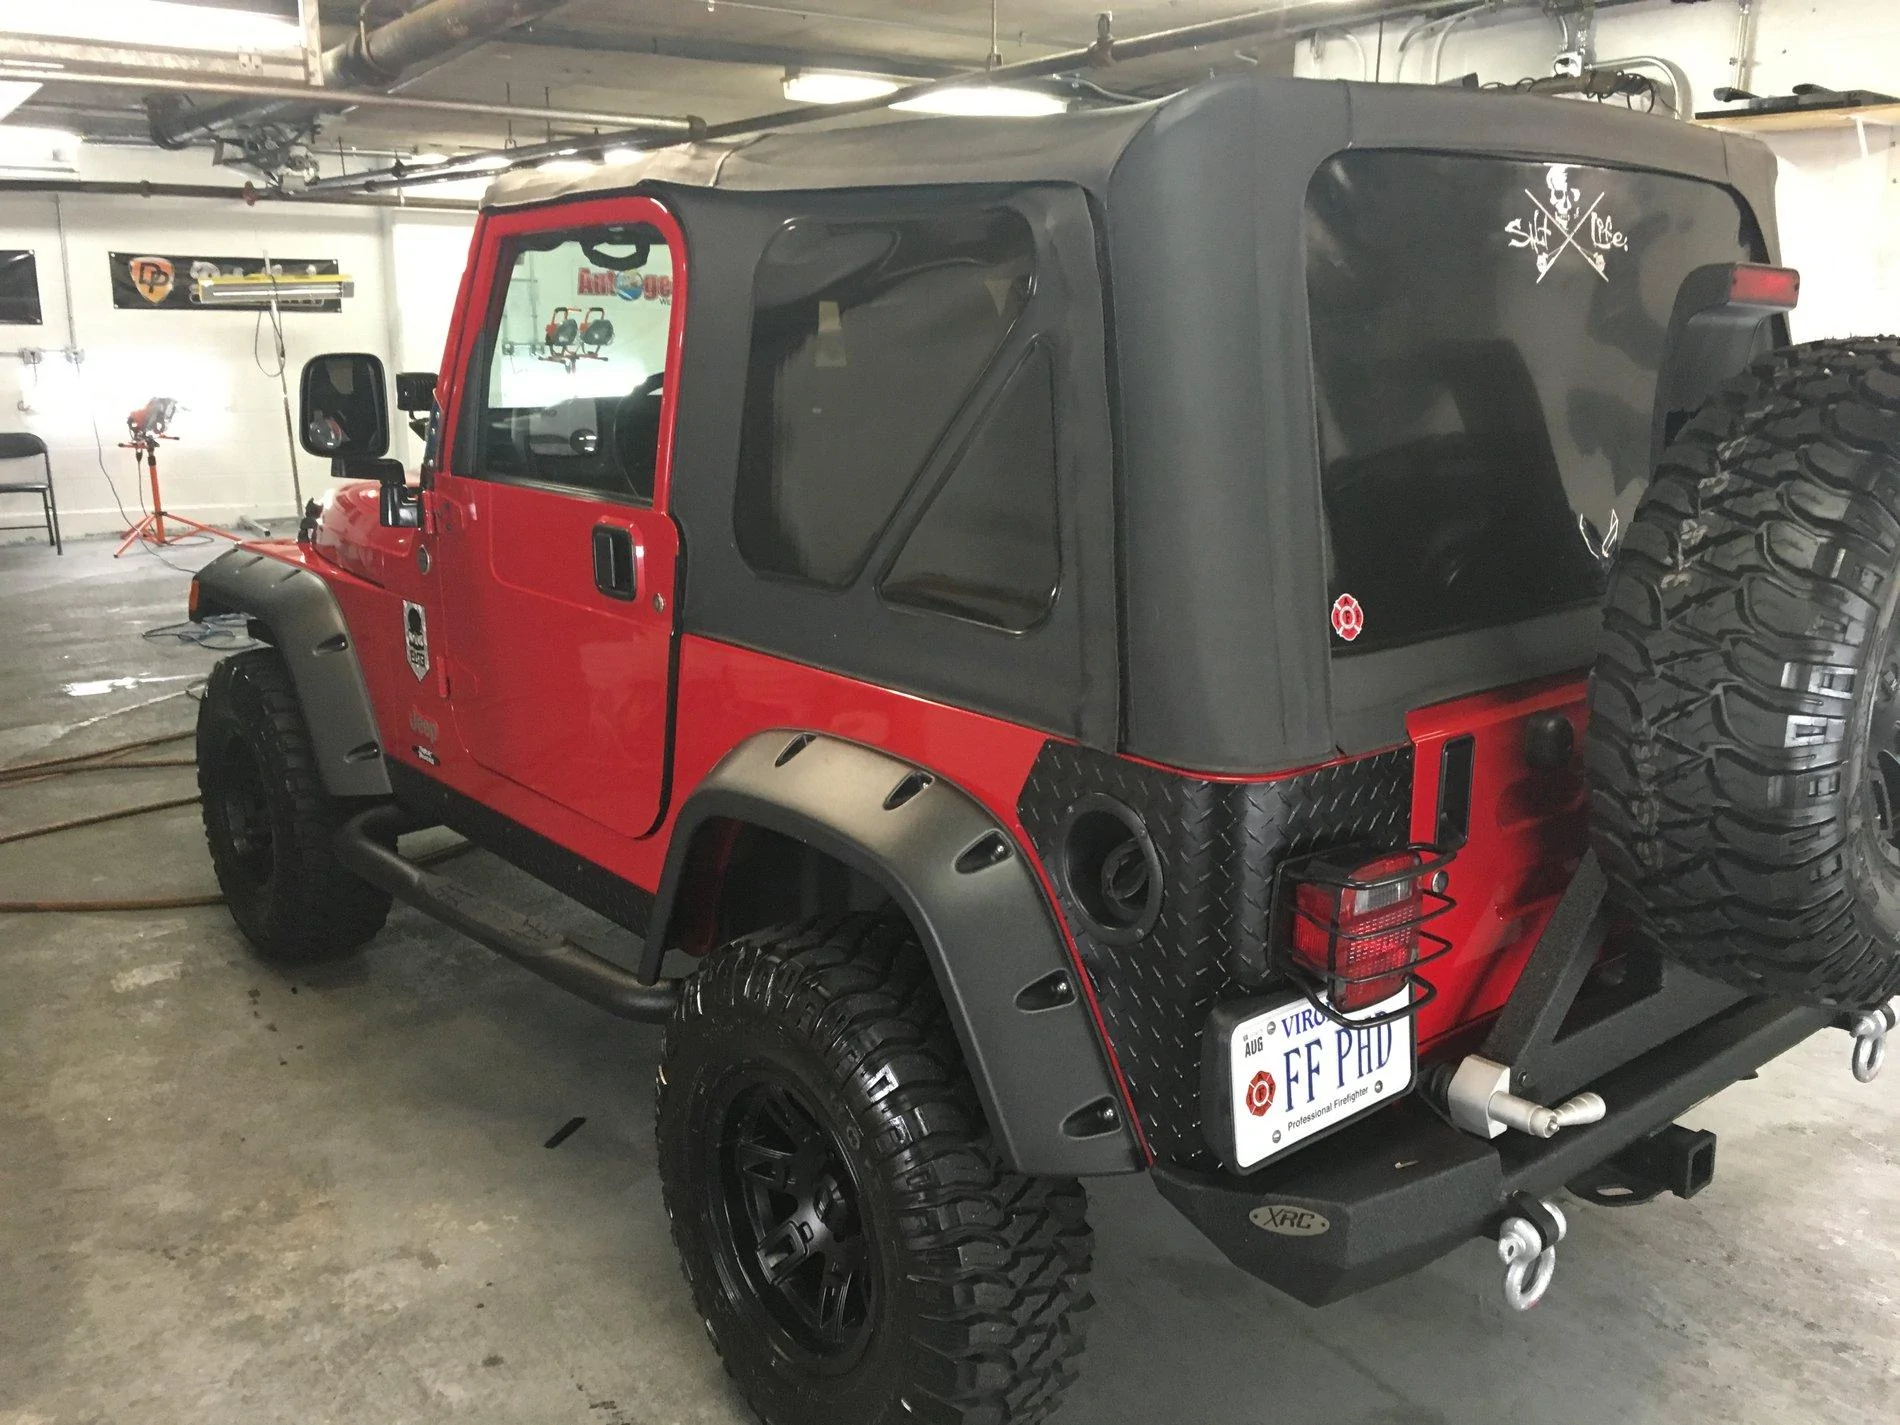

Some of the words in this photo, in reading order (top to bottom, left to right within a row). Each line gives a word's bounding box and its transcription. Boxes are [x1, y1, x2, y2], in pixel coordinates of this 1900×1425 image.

[1281, 1007, 1334, 1039] VIRG
[1245, 1036, 1263, 1058] AUG
[1283, 1038, 1323, 1113] FF
[1334, 1011, 1392, 1089] PHD
[1287, 1102, 1333, 1131] Professional
[1333, 1086, 1369, 1109] Firefighter
[1263, 1207, 1315, 1229] XRC
